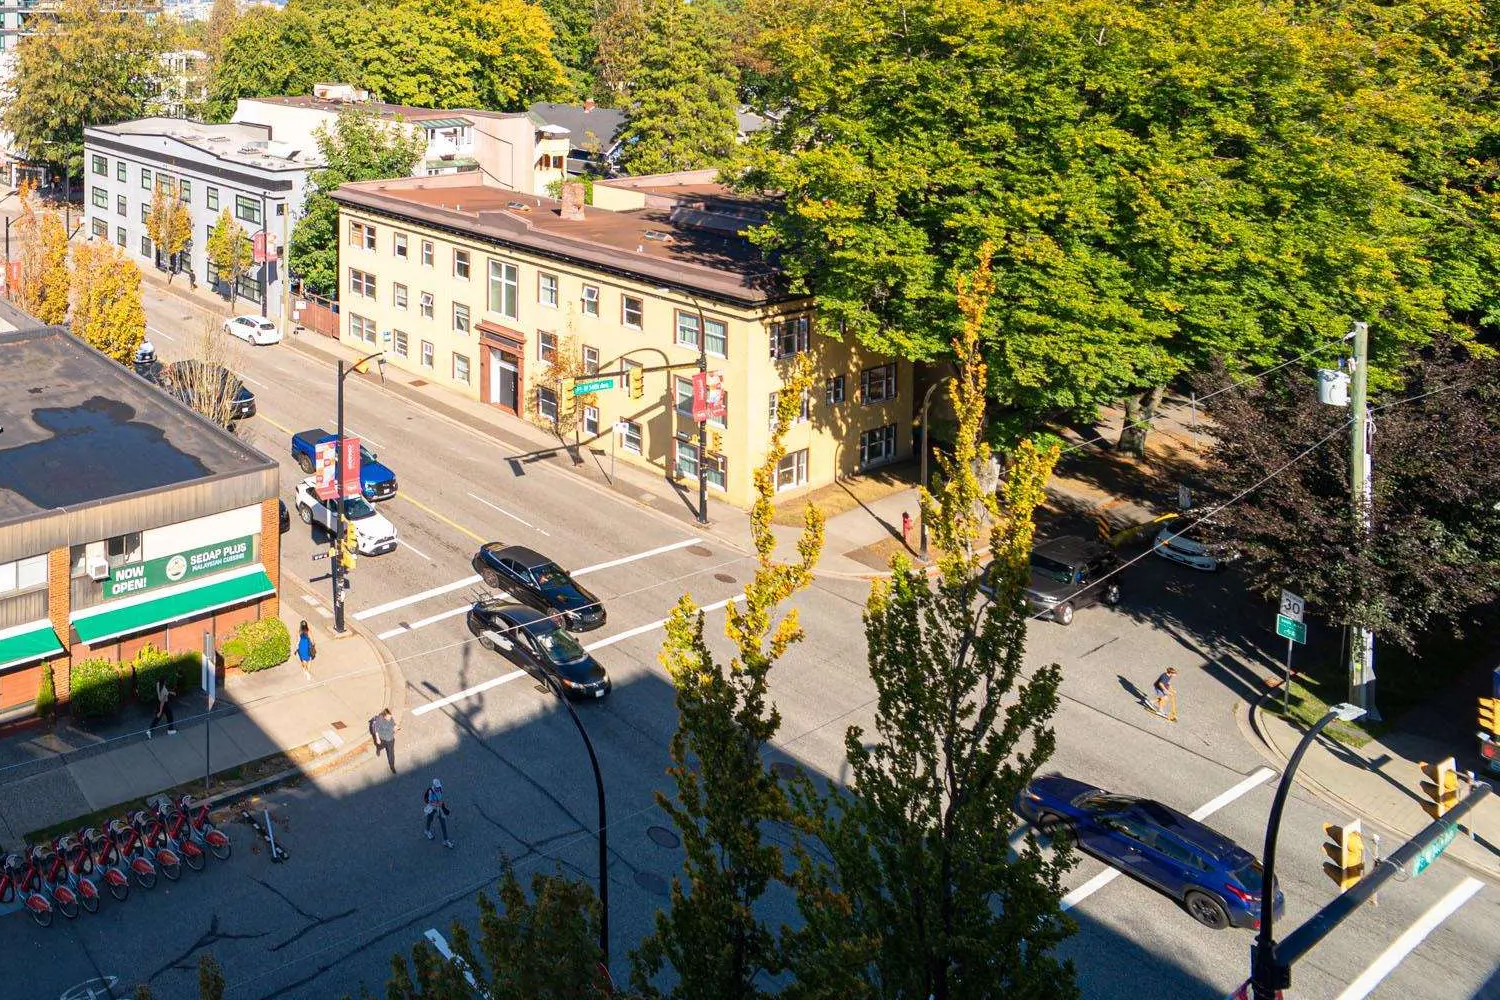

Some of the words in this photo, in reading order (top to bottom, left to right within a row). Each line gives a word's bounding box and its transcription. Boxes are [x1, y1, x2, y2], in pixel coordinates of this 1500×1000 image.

[190, 549, 221, 566] SEDAP
[223, 543, 247, 557] PLUS
[115, 566, 145, 581] NOW
[112, 577, 147, 594] OPEN!
[1284, 598, 1300, 614] 30
